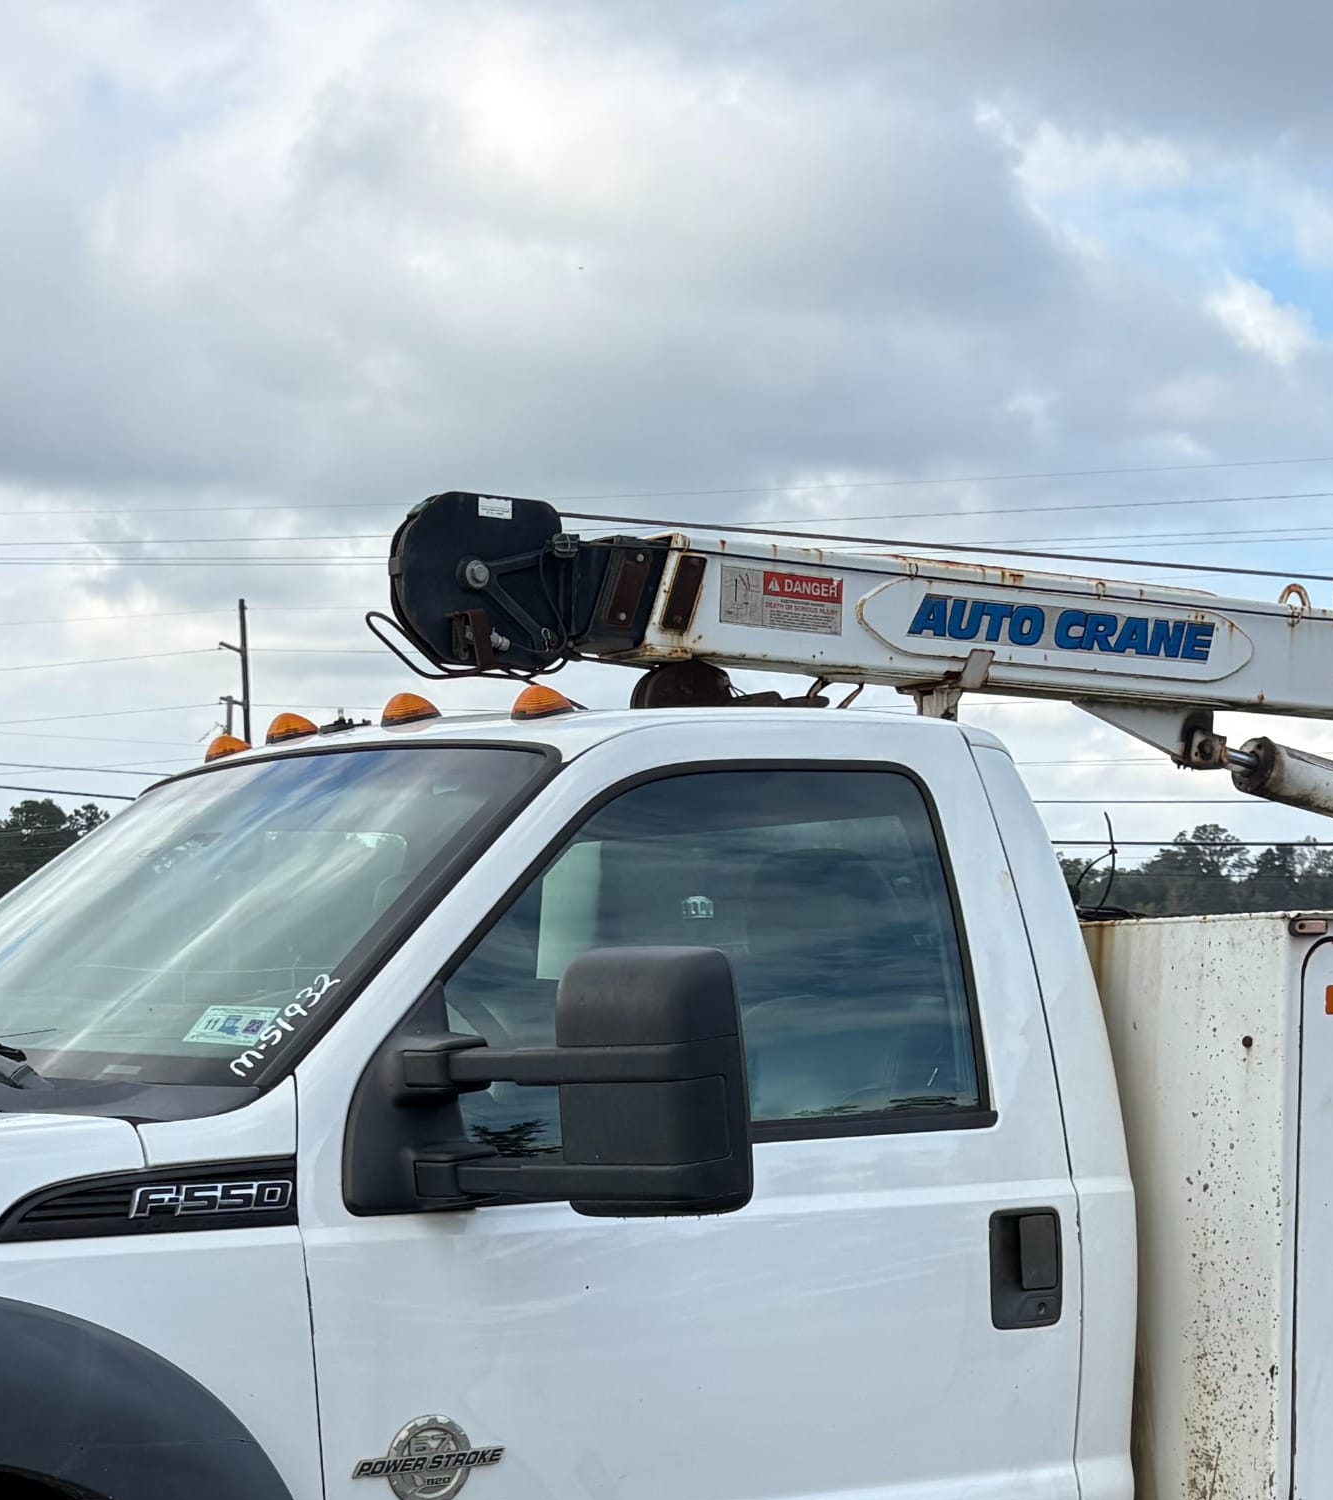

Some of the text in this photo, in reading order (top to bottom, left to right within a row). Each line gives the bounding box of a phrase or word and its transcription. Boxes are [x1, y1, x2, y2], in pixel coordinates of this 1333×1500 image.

[784, 579, 838, 598] DANGER
[908, 594, 1215, 661] AUTO CRANE
[204, 1017, 221, 1030] 11
[128, 1179, 293, 1220] F-550
[356, 1447, 506, 1477] POWER STROKE
